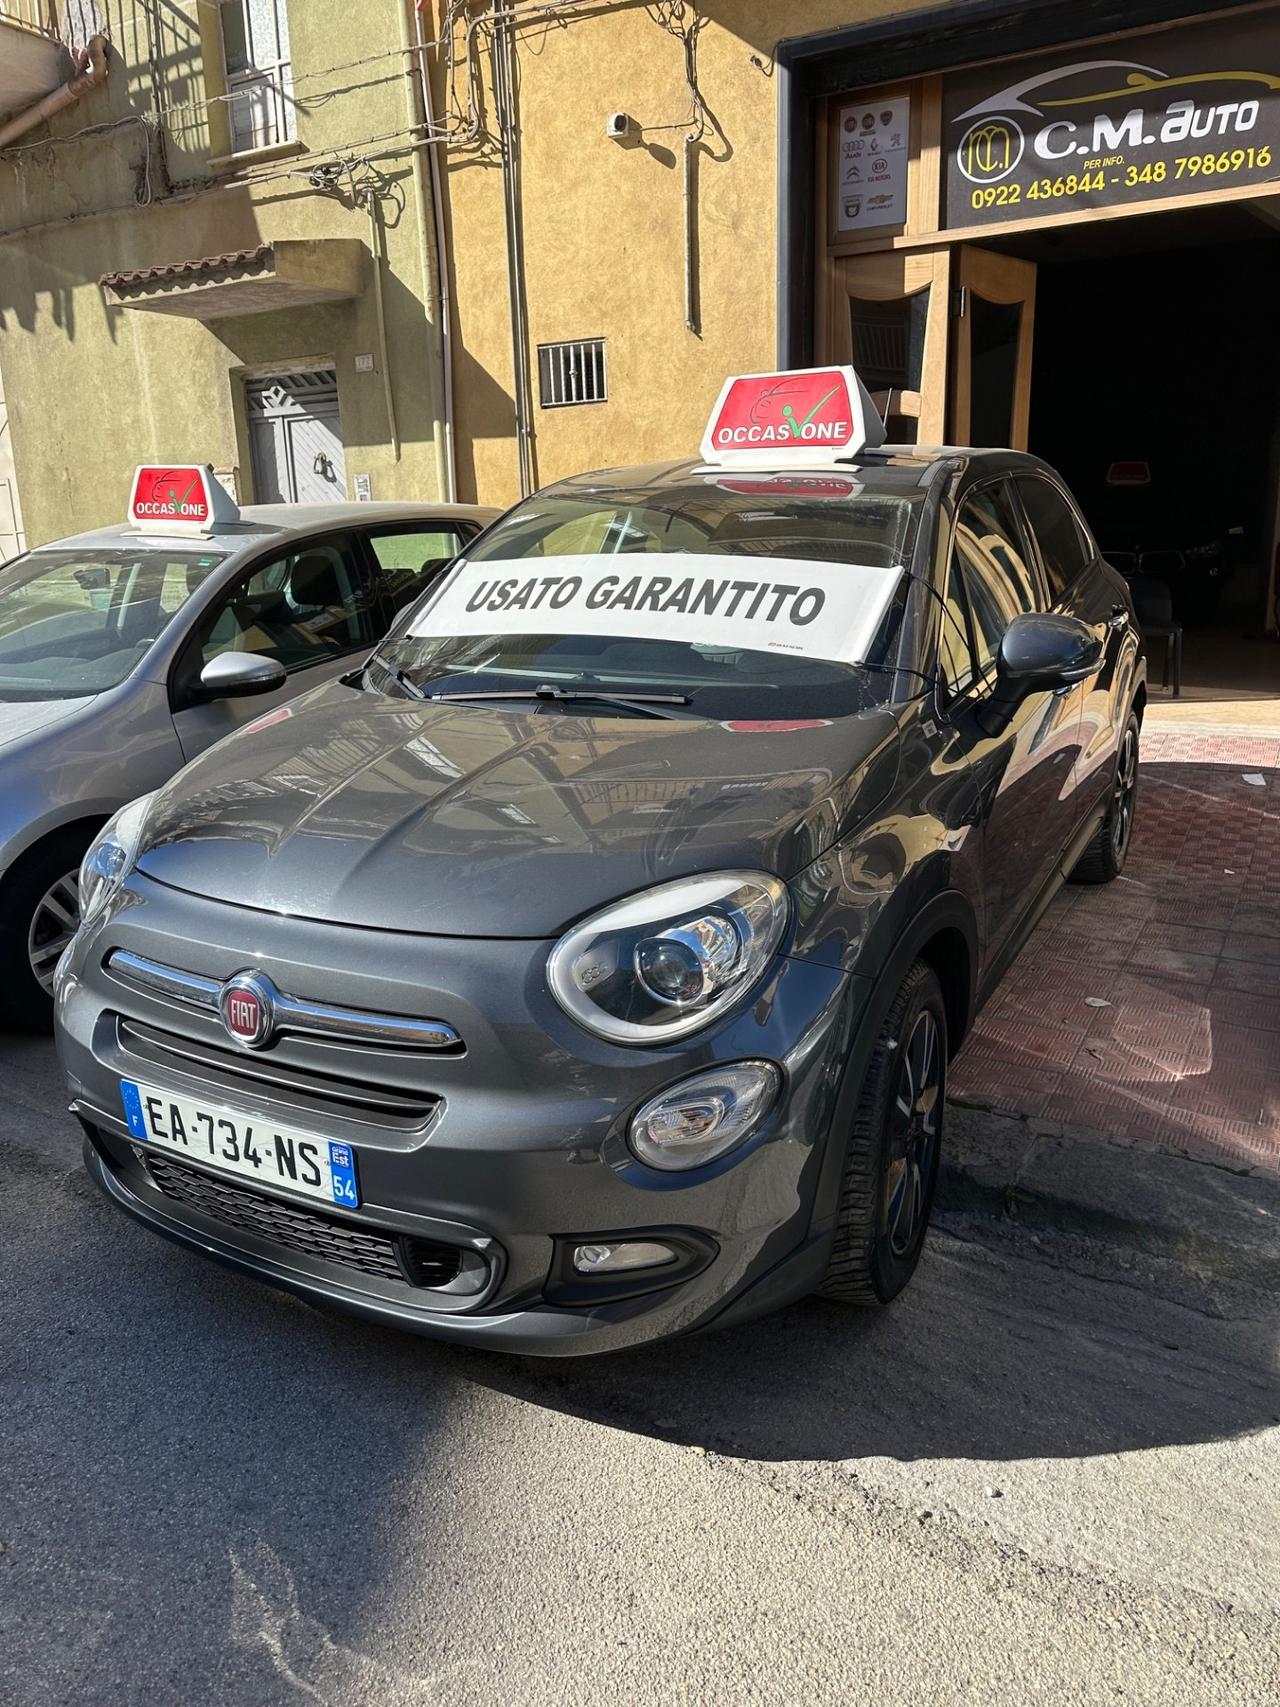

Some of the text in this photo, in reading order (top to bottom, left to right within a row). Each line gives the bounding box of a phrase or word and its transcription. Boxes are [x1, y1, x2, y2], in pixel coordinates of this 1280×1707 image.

[1034, 108, 1156, 160] C.M.
[971, 184, 1021, 209] 0922
[1026, 171, 1105, 200] 436844
[1124, 161, 1167, 186] 348
[1174, 146, 1272, 179] 7986916
[1083, 155, 1125, 170] PER INFO.
[465, 575, 826, 626] USATO GARANTITO
[231, 999, 256, 1029] FIAT
[132, 1115, 139, 1127] F
[146, 1096, 321, 1187] EA-734-NS
[332, 1152, 349, 1167] Est
[333, 1175, 355, 1200] 54
